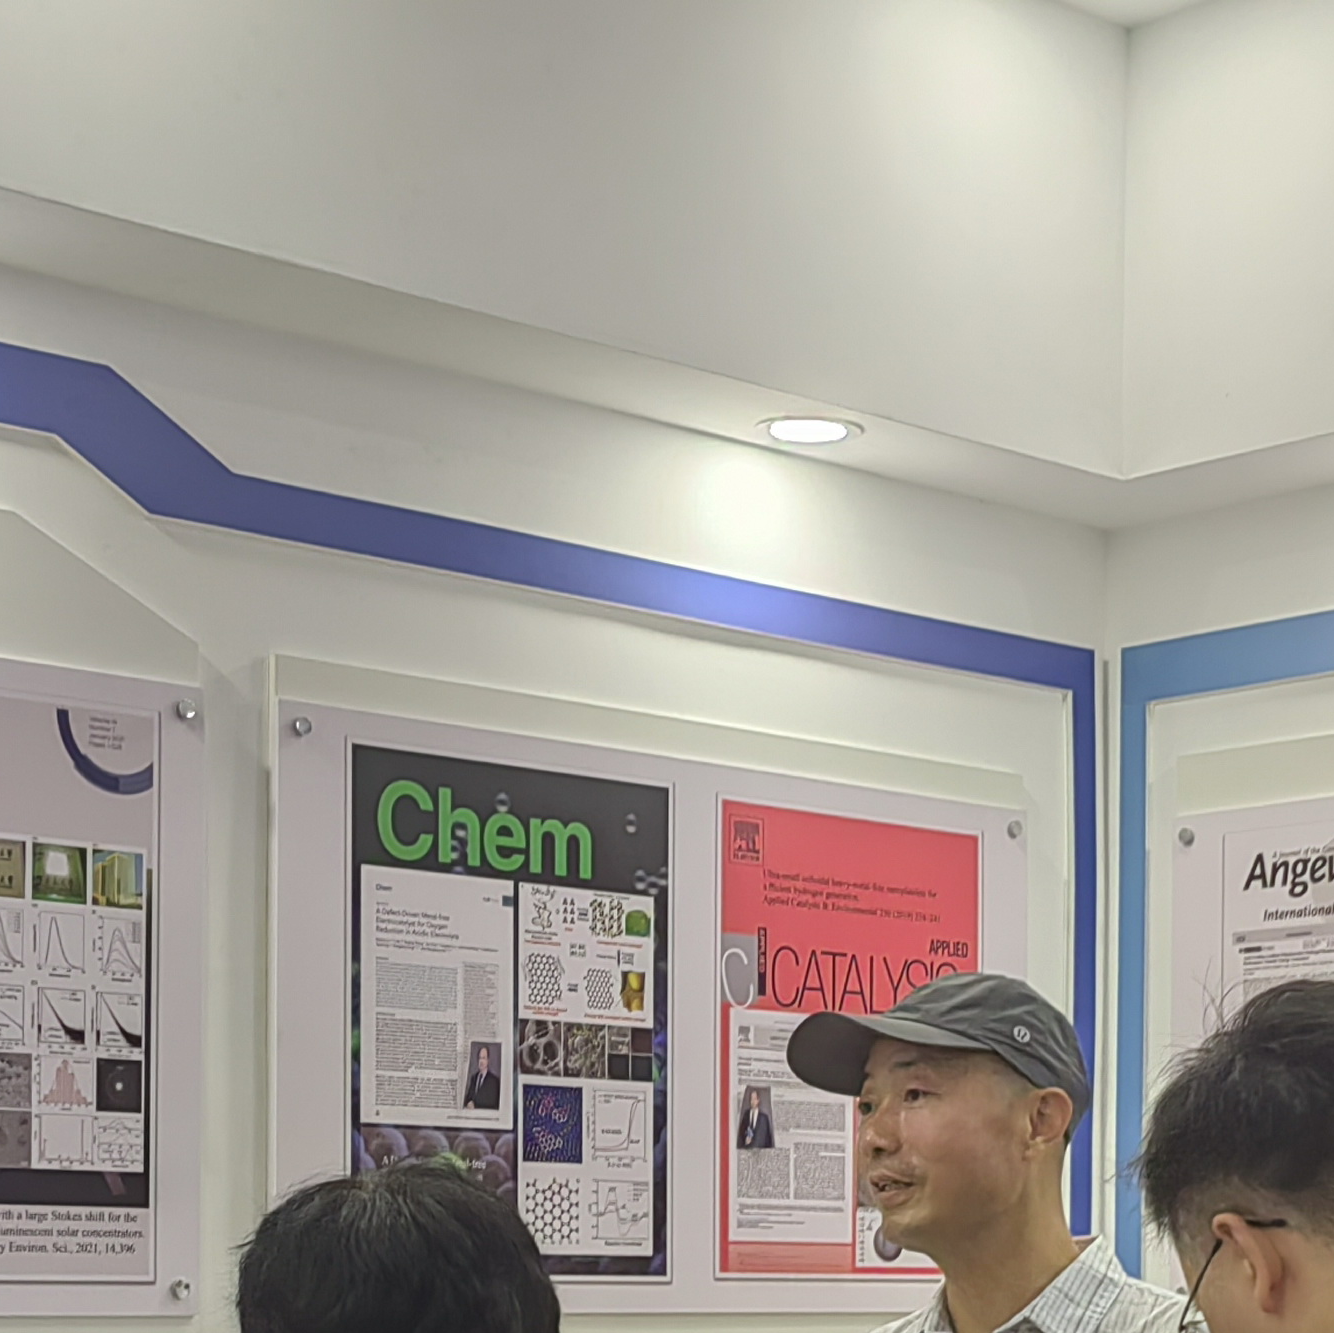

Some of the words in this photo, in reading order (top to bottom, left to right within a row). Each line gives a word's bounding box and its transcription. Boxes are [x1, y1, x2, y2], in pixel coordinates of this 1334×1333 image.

[377, 779, 593, 880] Chem
[929, 939, 969, 958] APPLIED
[25, 1209, 48, 1224] large
[51, 1210, 83, 1222] Stokes
[84, 1210, 105, 1222] shift
[108, 1211, 121, 1223] for
[124, 1211, 138, 1223] the
[56, 1226, 79, 1238] solar
